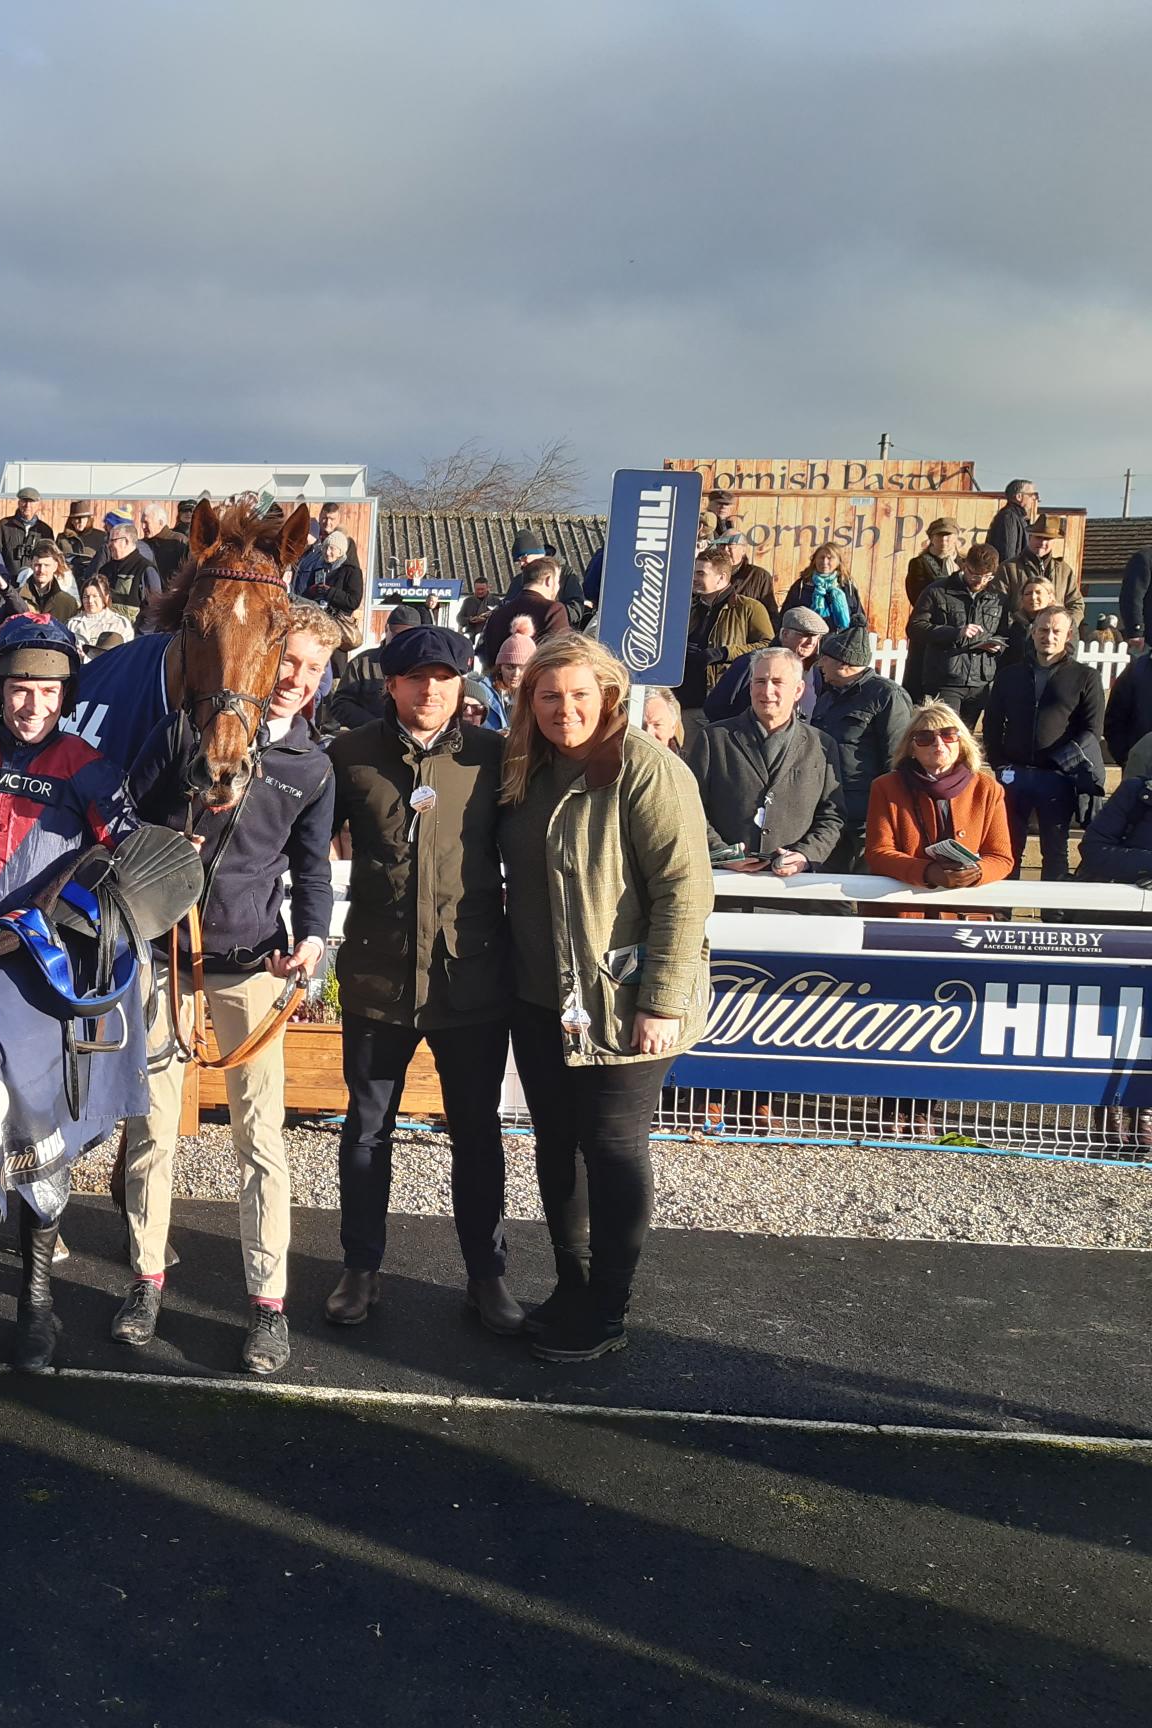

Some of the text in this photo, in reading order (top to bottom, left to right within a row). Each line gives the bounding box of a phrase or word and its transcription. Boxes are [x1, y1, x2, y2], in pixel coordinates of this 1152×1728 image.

[693, 463, 830, 490] ornish
[727, 511, 880, 548] ornish
[622, 485, 673, 671] William HILL
[983, 943, 1026, 951] RACECOURSE
[984, 929, 1104, 947] WETHERBY
[704, 960, 1152, 1060] William HILL
